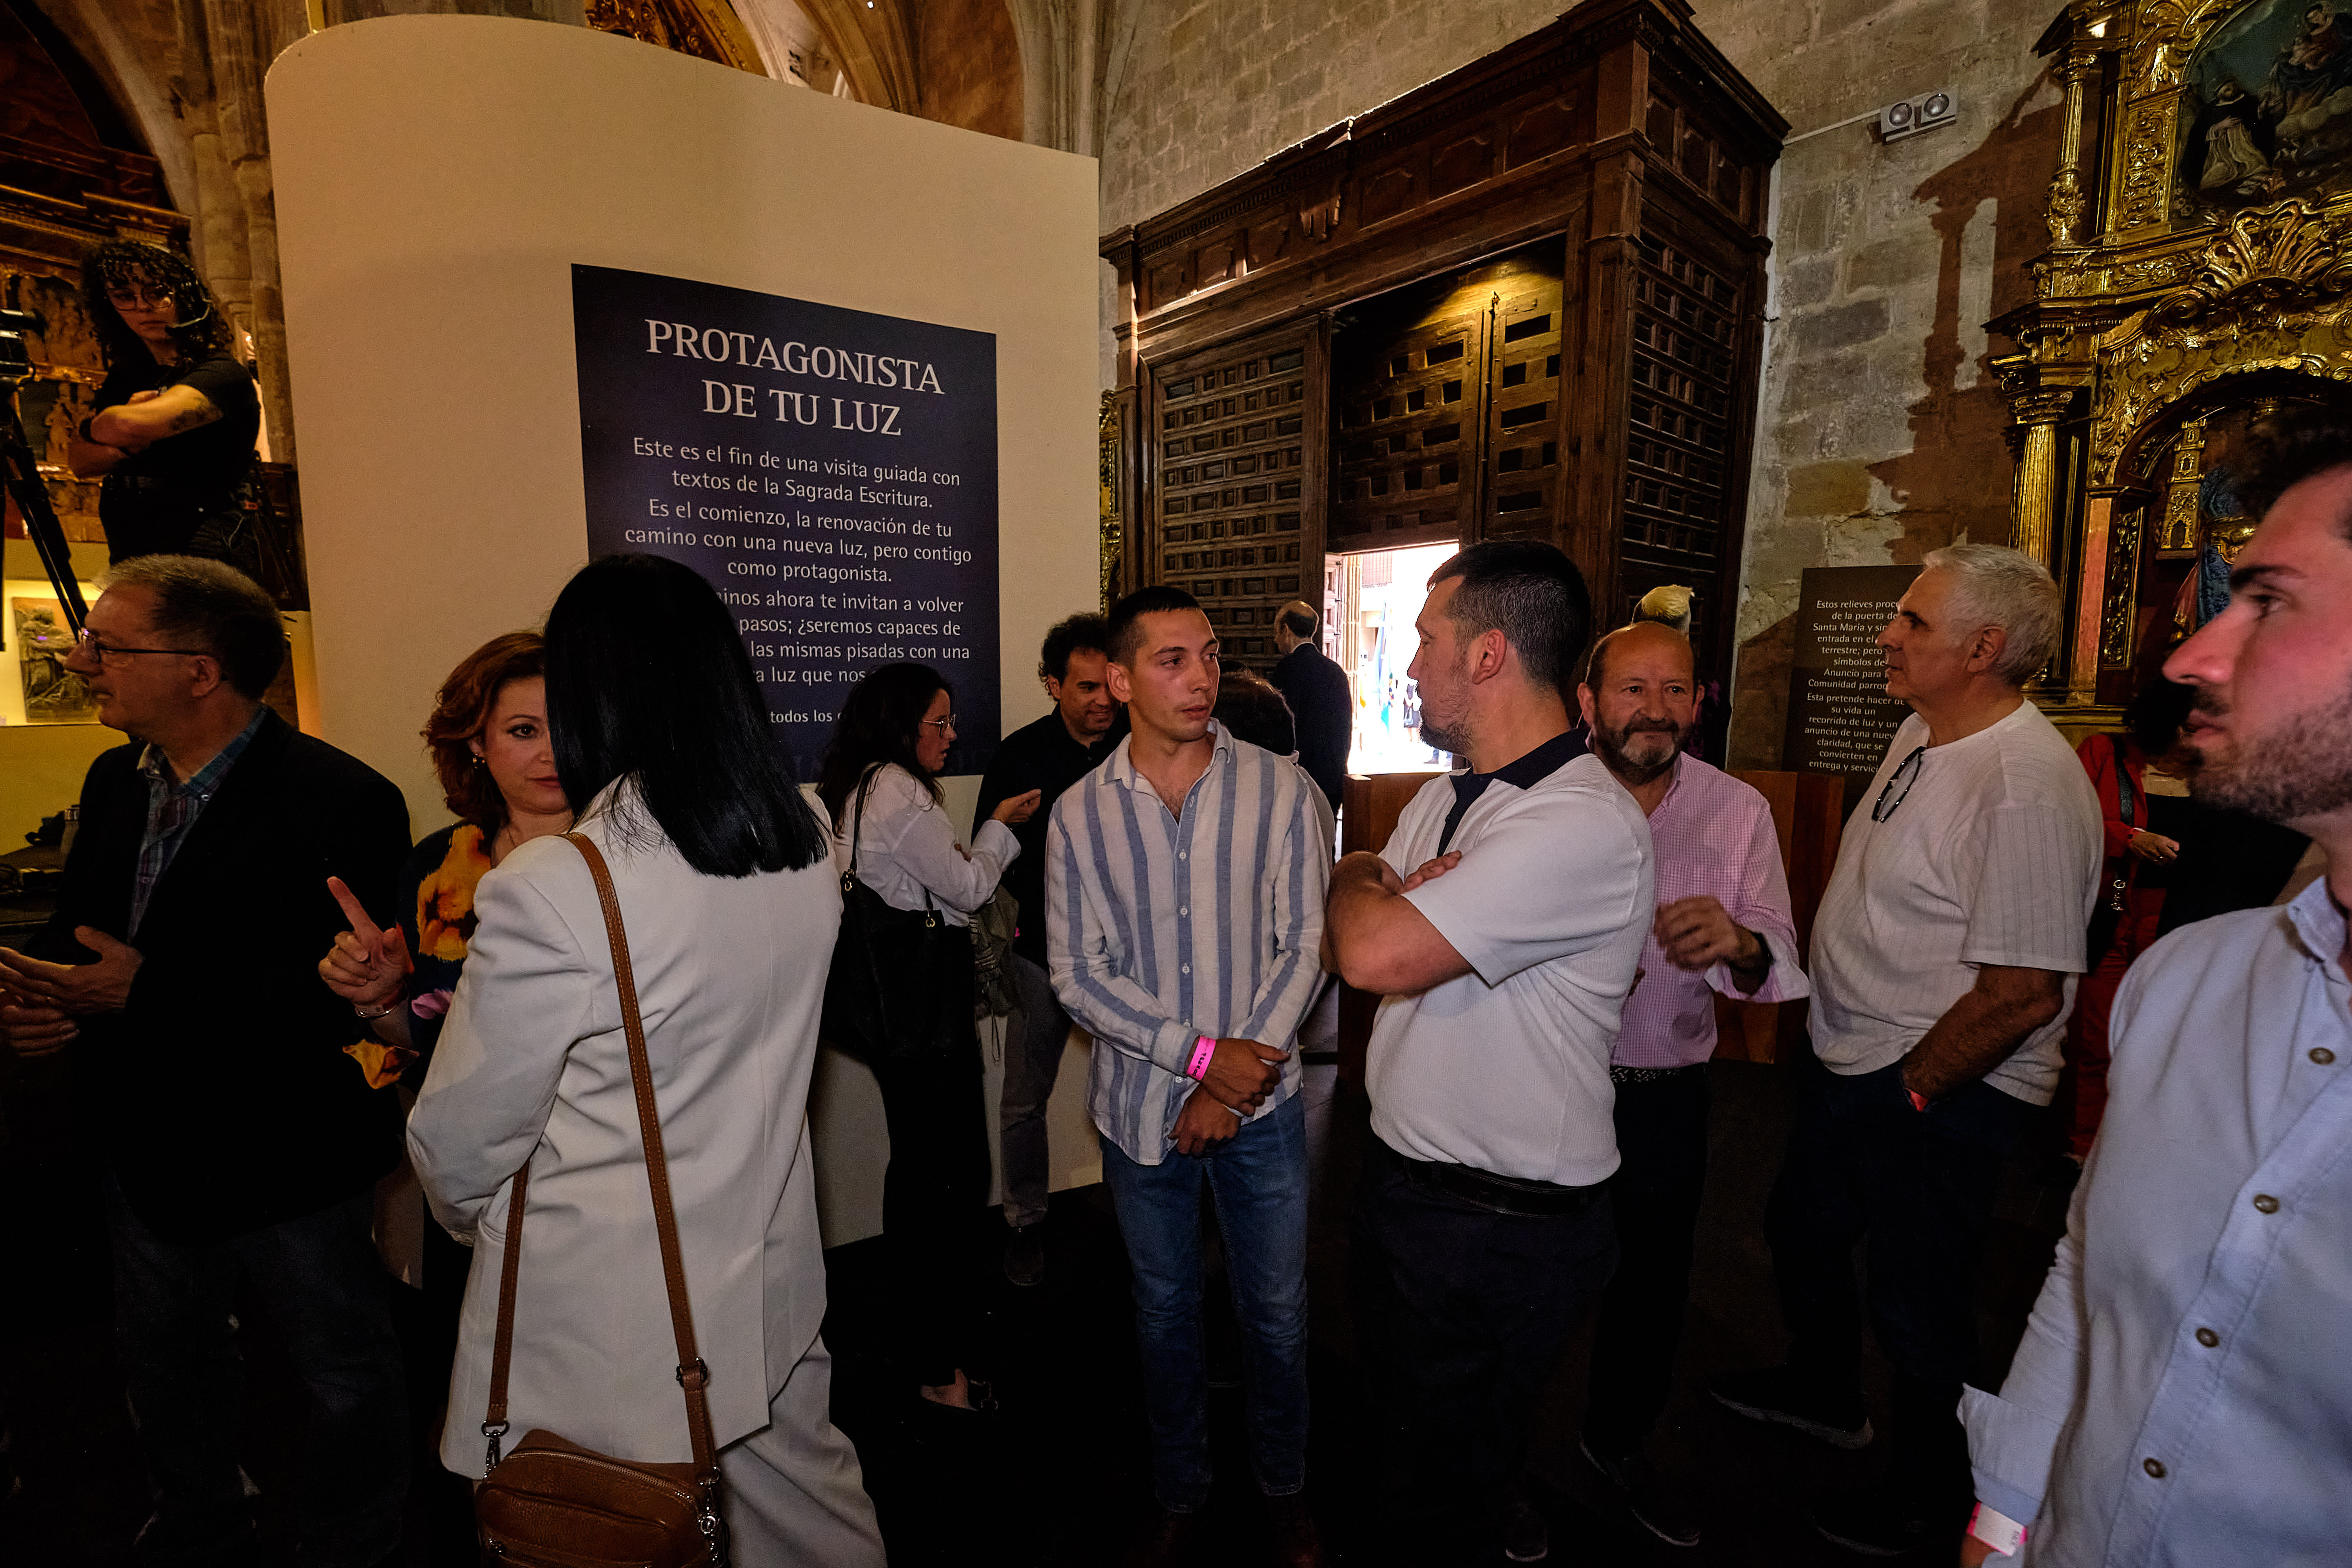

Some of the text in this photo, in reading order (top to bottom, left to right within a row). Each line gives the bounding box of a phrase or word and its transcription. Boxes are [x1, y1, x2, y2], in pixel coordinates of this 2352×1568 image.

[645, 319, 945, 394] PROTAGONISTA
[702, 380, 901, 436] DE TU LUZ
[634, 437, 959, 485] Este es el fin de una visita guiada con
[672, 470, 932, 507] textos de la Sagrada Escritura.
[650, 499, 951, 537] Es el comienzo, la renovación de tu
[626, 527, 971, 565] camino con una nueva luz, pero contigo
[728, 562, 891, 583] como protagonista.
[766, 590, 813, 607] ahora
[820, 594, 836, 608] te
[843, 593, 897, 610] invitan
[904, 600, 911, 610] a
[918, 597, 963, 612] volver
[1855, 612, 1884, 622] puerta
[740, 619, 960, 639] pasos; ¿seremos capaces de
[1867, 625, 1873, 633] y
[751, 641, 969, 662] las mismas pisadas con una
[772, 666, 796, 682] luz
[802, 671, 832, 686] que
[839, 671, 865, 682] nos
[1824, 668, 1859, 677] Anuncio
[1808, 679, 1856, 688] Comunidad
[1827, 695, 1864, 703] pretende
[1867, 696, 1891, 704] hacer
[770, 710, 808, 723] todos
[814, 710, 832, 722] los
[1844, 706, 1861, 714] vida
[1817, 738, 1852, 749] claridad,
[1820, 750, 1864, 760] convierten
[1809, 761, 1840, 771] entrega
[1851, 764, 1878, 773] servici
